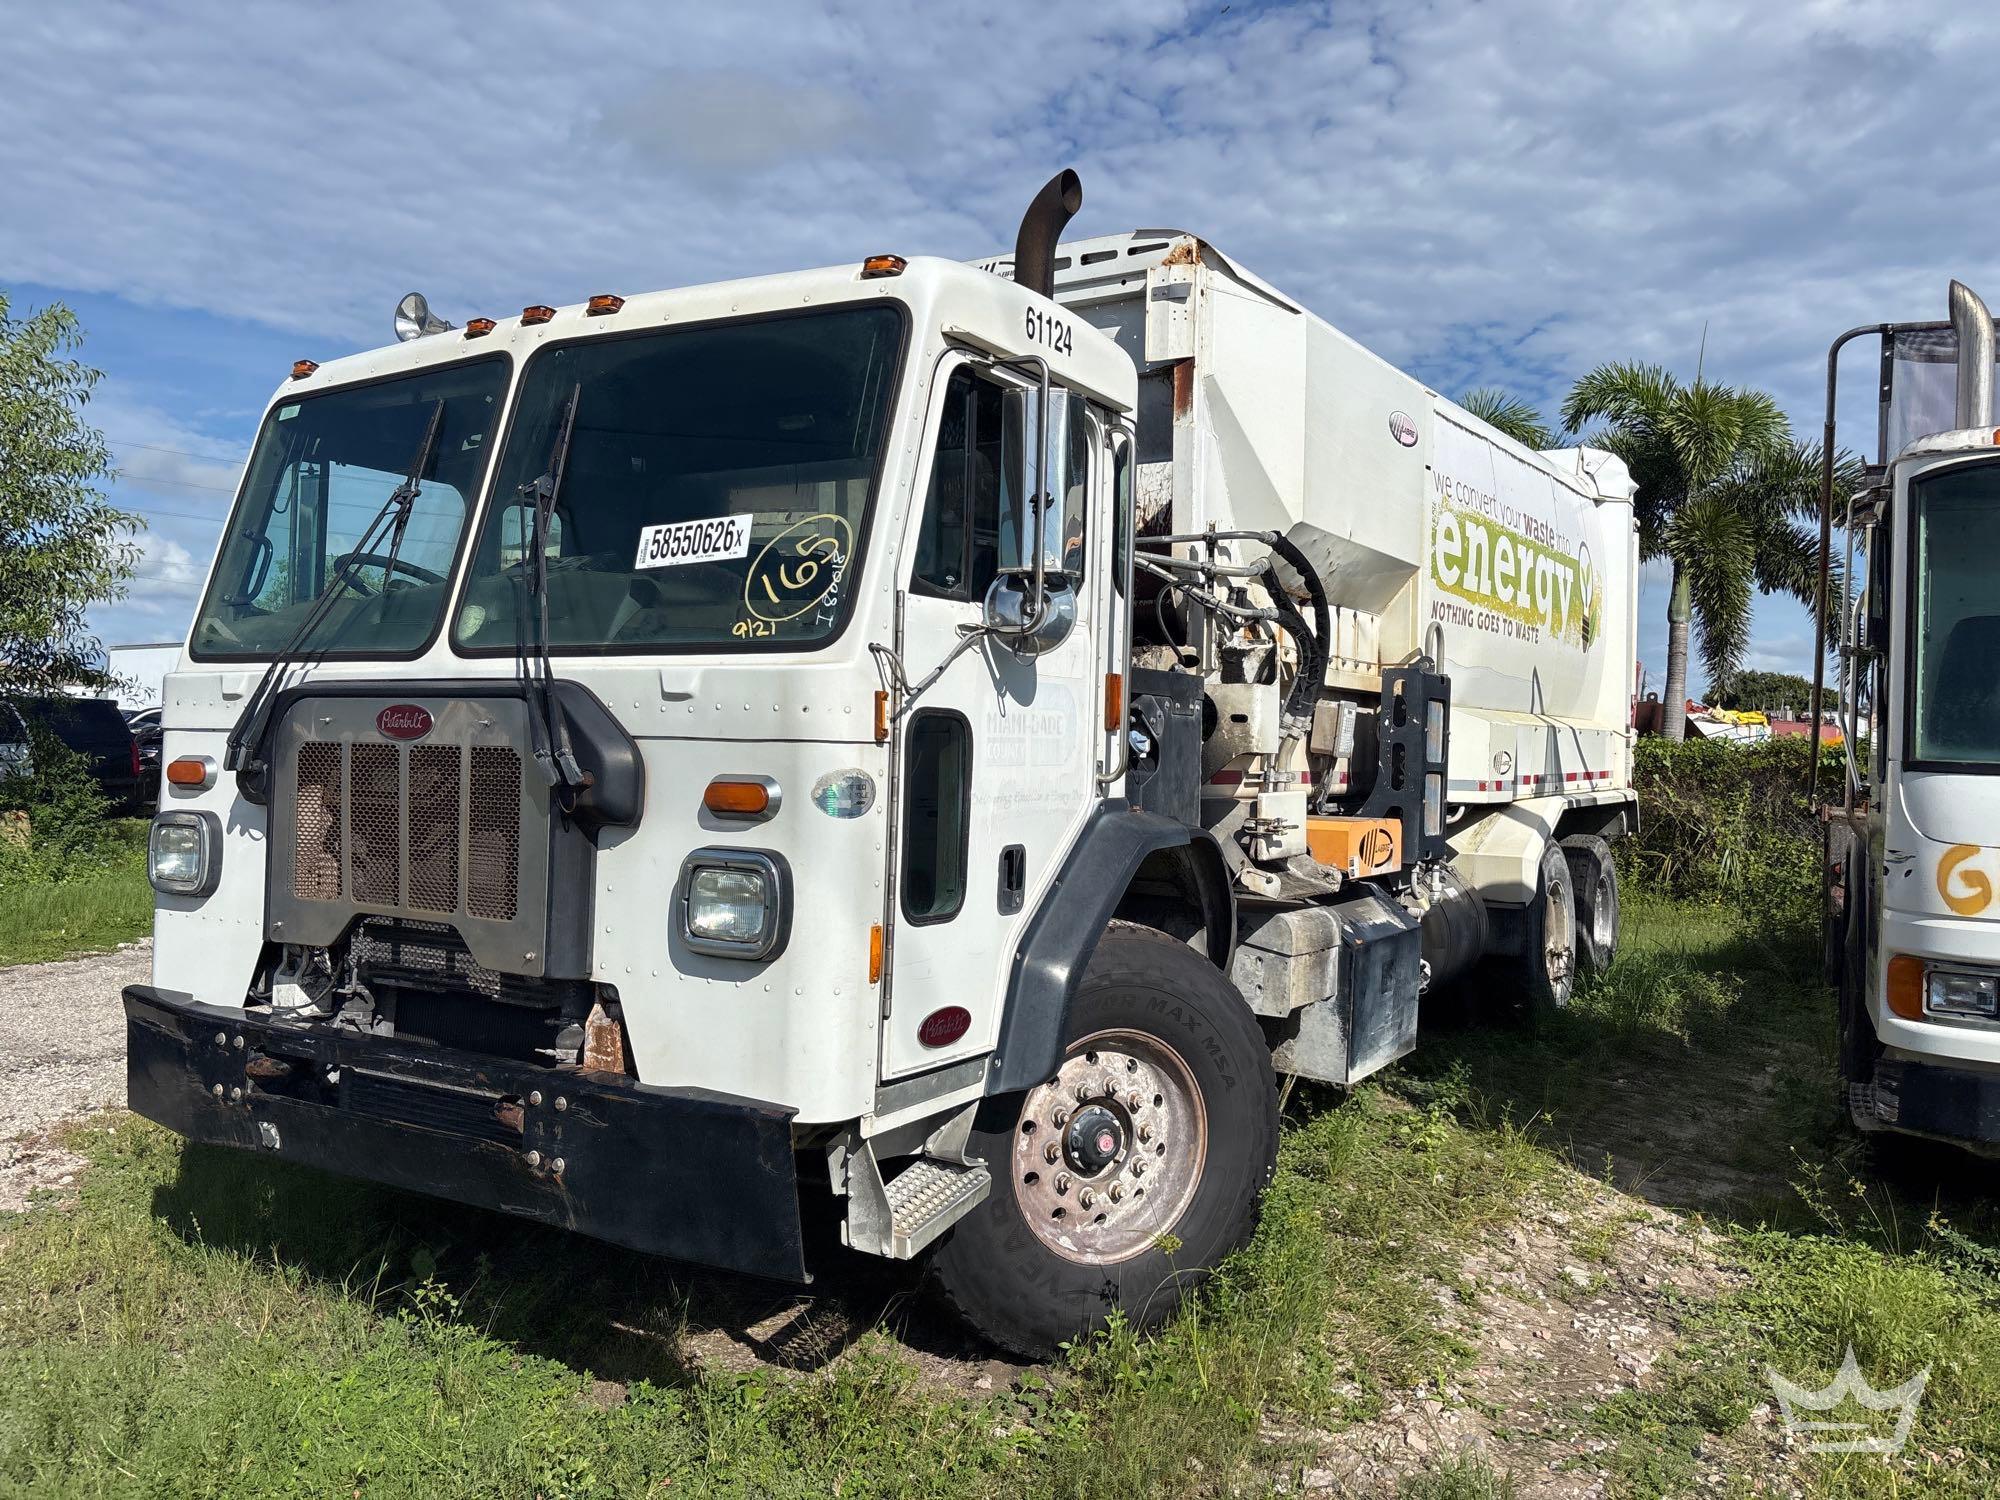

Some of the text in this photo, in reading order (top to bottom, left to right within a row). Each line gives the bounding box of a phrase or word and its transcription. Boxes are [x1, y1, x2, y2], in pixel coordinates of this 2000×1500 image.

[1026, 306, 1073, 356] 61124
[1433, 470, 1452, 498] we
[1456, 480, 1498, 519] convert
[1499, 501, 1523, 530] your
[1523, 512, 1555, 547] waste
[761, 533, 839, 603] 165
[1435, 512, 1574, 639] energy
[1430, 600, 1540, 645] NOTHING GOES TO WASTE
[381, 710, 427, 730] Peterbilt
[1146, 996, 1202, 1034] MAX
